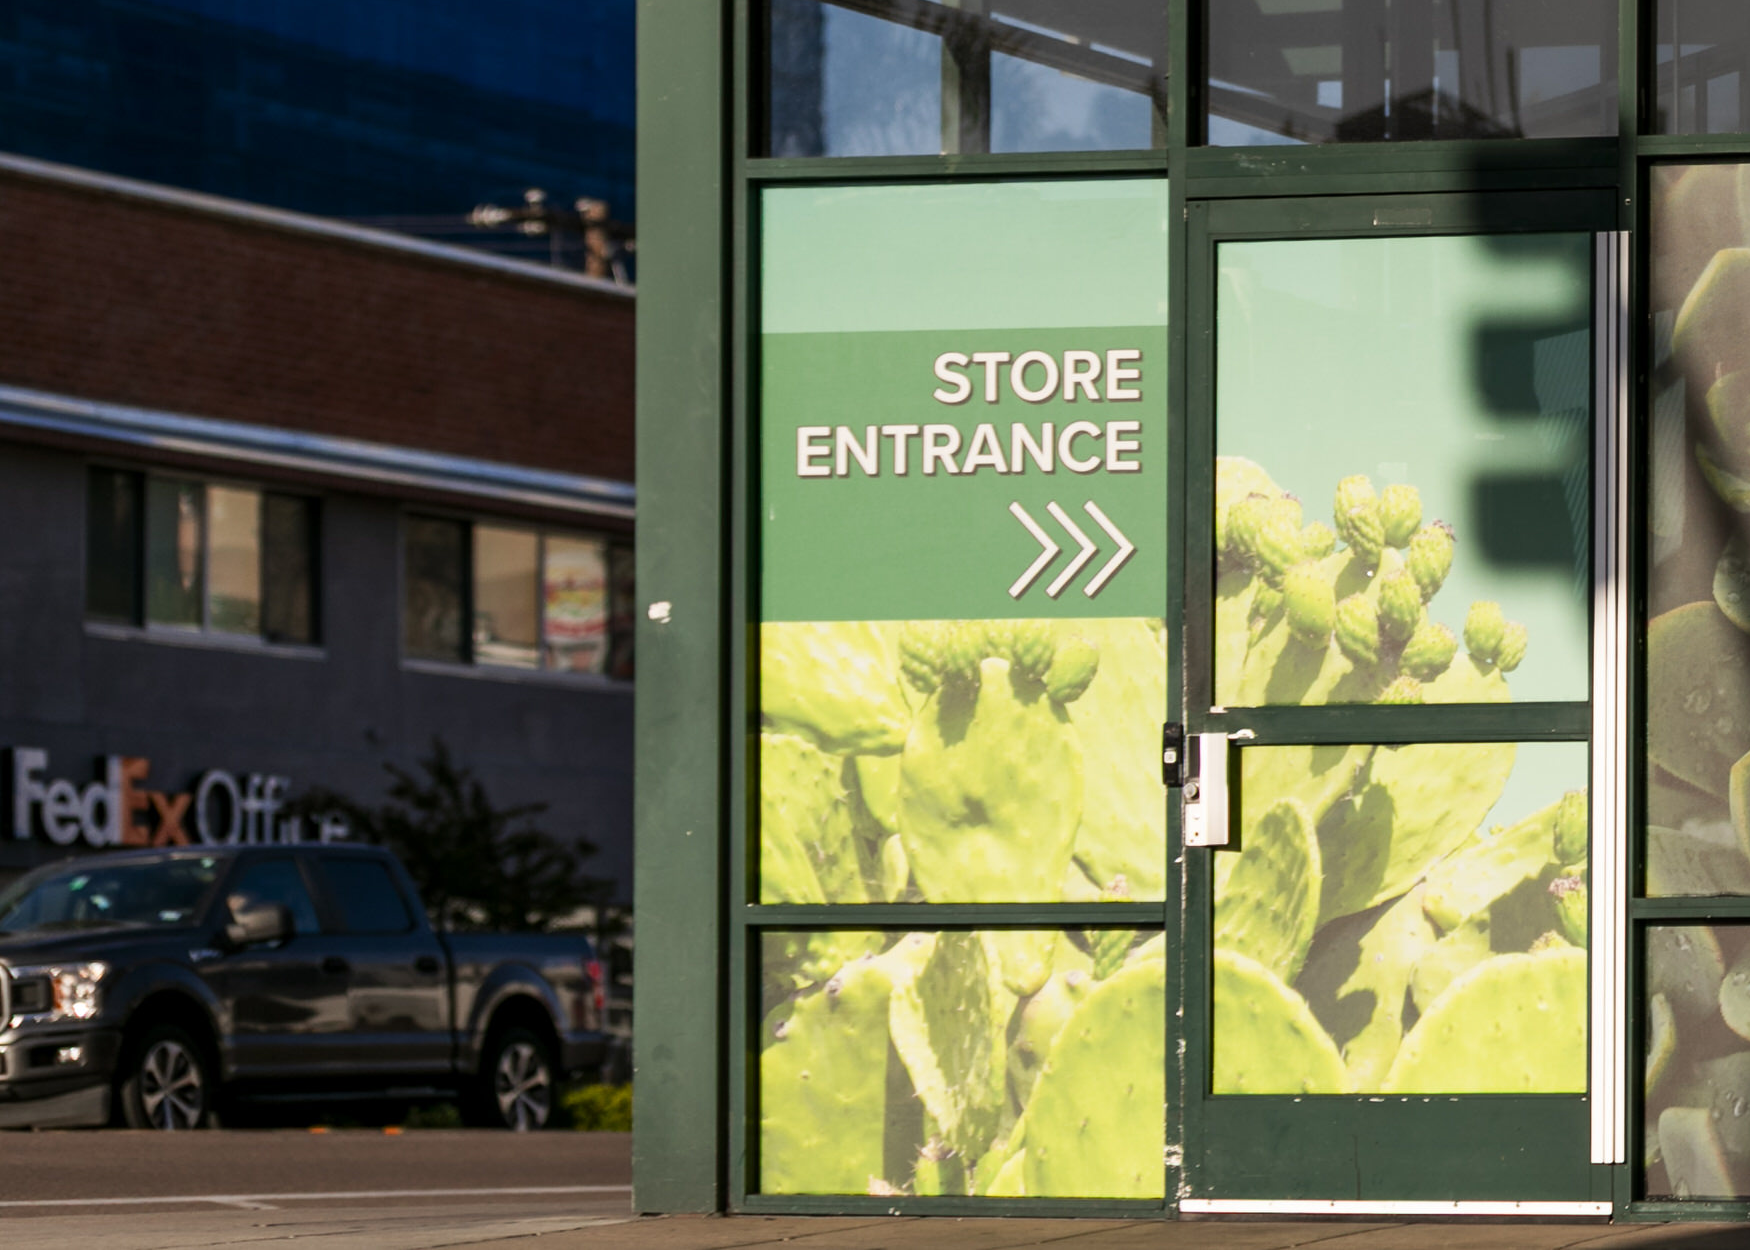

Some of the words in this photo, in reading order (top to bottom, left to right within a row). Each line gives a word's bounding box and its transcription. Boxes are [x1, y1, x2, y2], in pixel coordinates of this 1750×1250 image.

[932, 349, 1142, 405] STORE
[796, 420, 1142, 478] ENTRANCE
[12, 746, 192, 848] FedEx
